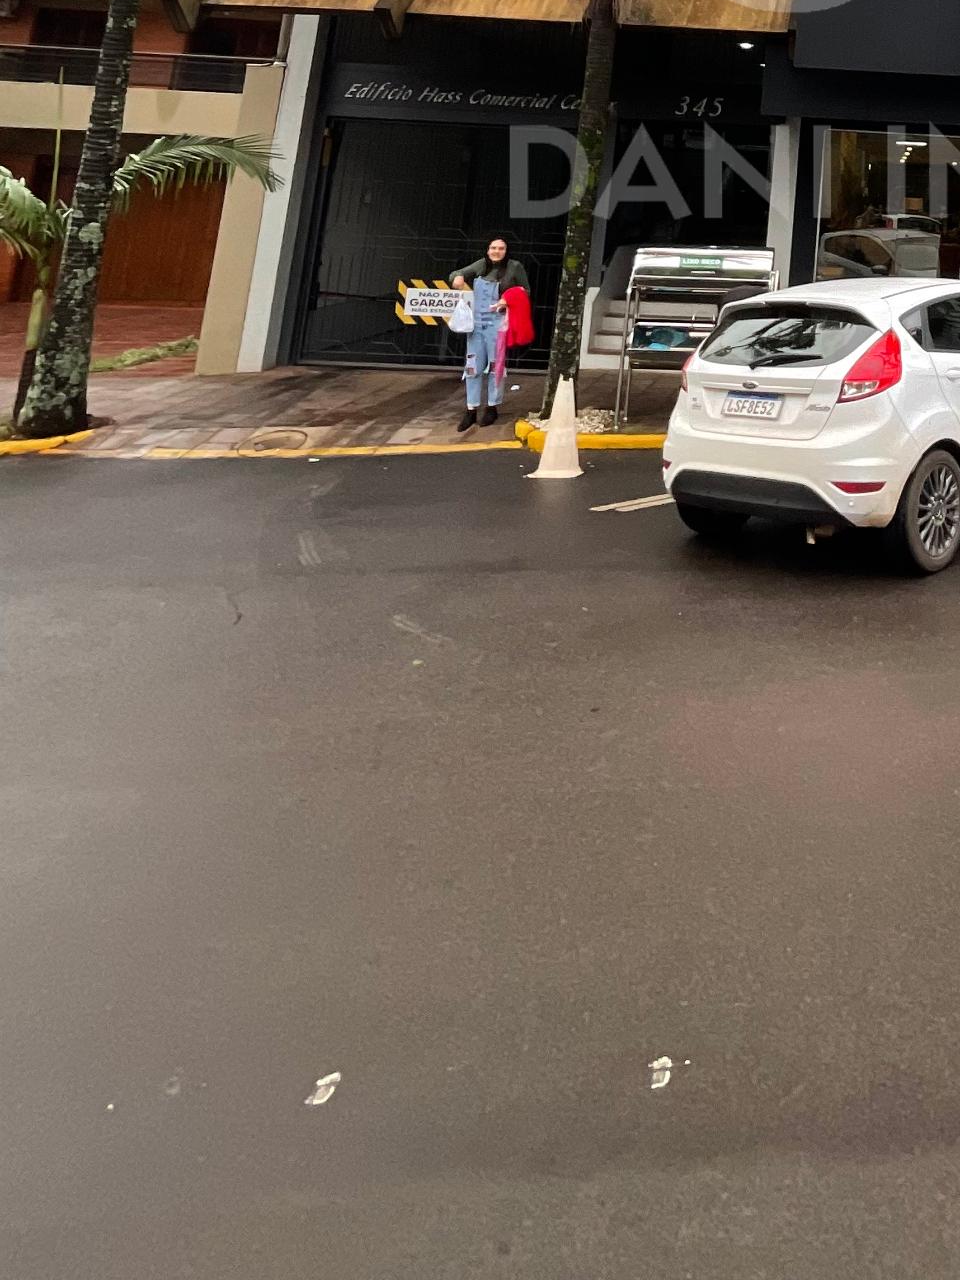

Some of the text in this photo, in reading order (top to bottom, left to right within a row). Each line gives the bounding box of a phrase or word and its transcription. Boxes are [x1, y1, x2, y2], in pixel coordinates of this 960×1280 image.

[418, 86, 463, 103] Hass
[469, 89, 557, 110] Comercial
[674, 95, 724, 117] 345
